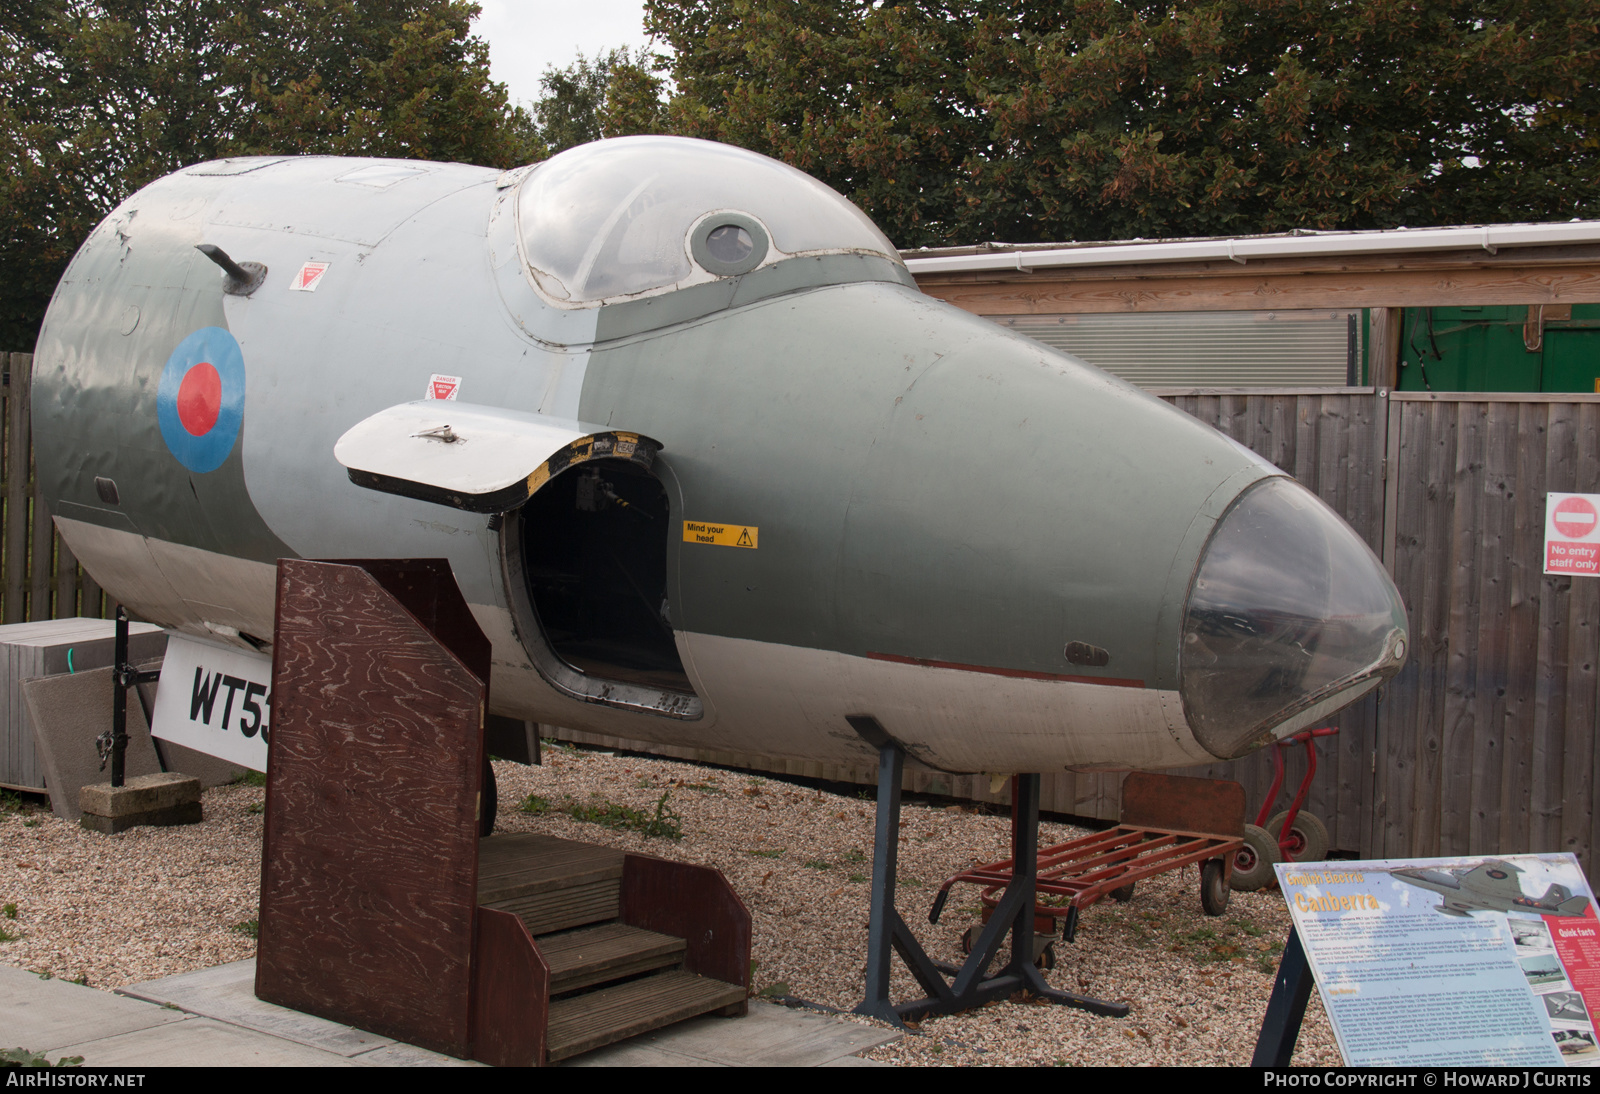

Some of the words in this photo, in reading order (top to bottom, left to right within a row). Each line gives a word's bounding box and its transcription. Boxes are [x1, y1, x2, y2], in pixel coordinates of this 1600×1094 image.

[618, 443, 634, 452] HEAD
[687, 523, 706, 532] Mind
[707, 526, 724, 534] your
[696, 534, 715, 543] head
[1551, 545, 1566, 555] No
[1568, 547, 1597, 558] entry
[1549, 558, 1573, 568] staff
[1575, 560, 1598, 571] only
[1286, 872, 1323, 887] English
[1323, 871, 1365, 884] Electric
[1294, 891, 1380, 912] Canberra
[1558, 928, 1578, 938] Quick
[1577, 927, 1596, 937] facts
